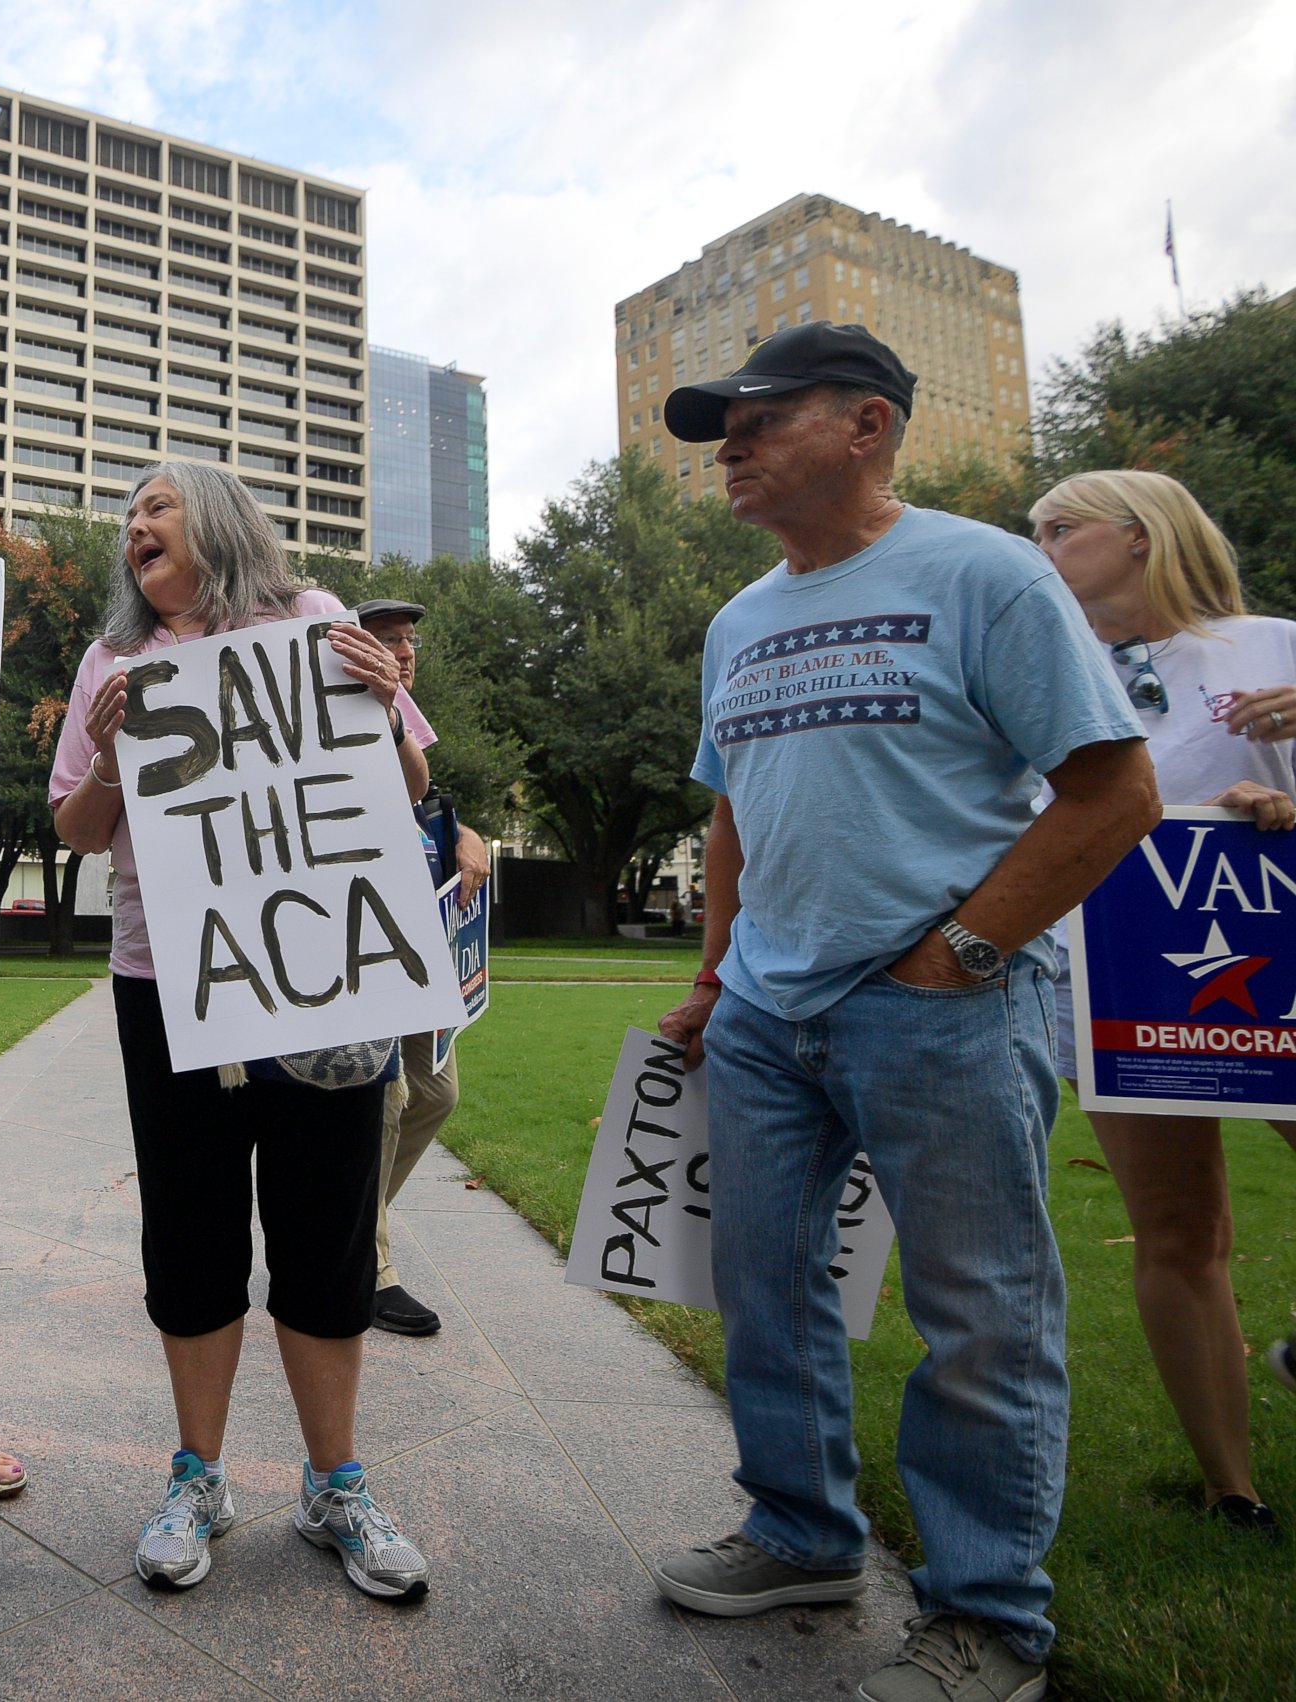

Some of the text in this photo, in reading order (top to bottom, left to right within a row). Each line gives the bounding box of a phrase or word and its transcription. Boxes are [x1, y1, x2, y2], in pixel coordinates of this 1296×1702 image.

[119, 622, 383, 797] SAVE
[719, 688, 771, 713] VOTED
[775, 681, 806, 701] FOR
[810, 671, 918, 691] HILLARY
[727, 650, 895, 693] DON'T BLAME ME,
[164, 774, 384, 886] THE
[194, 875, 430, 1022] ACA
[1136, 1024, 1296, 1054] DEMOCRA
[601, 1038, 686, 1288] PAXTON
